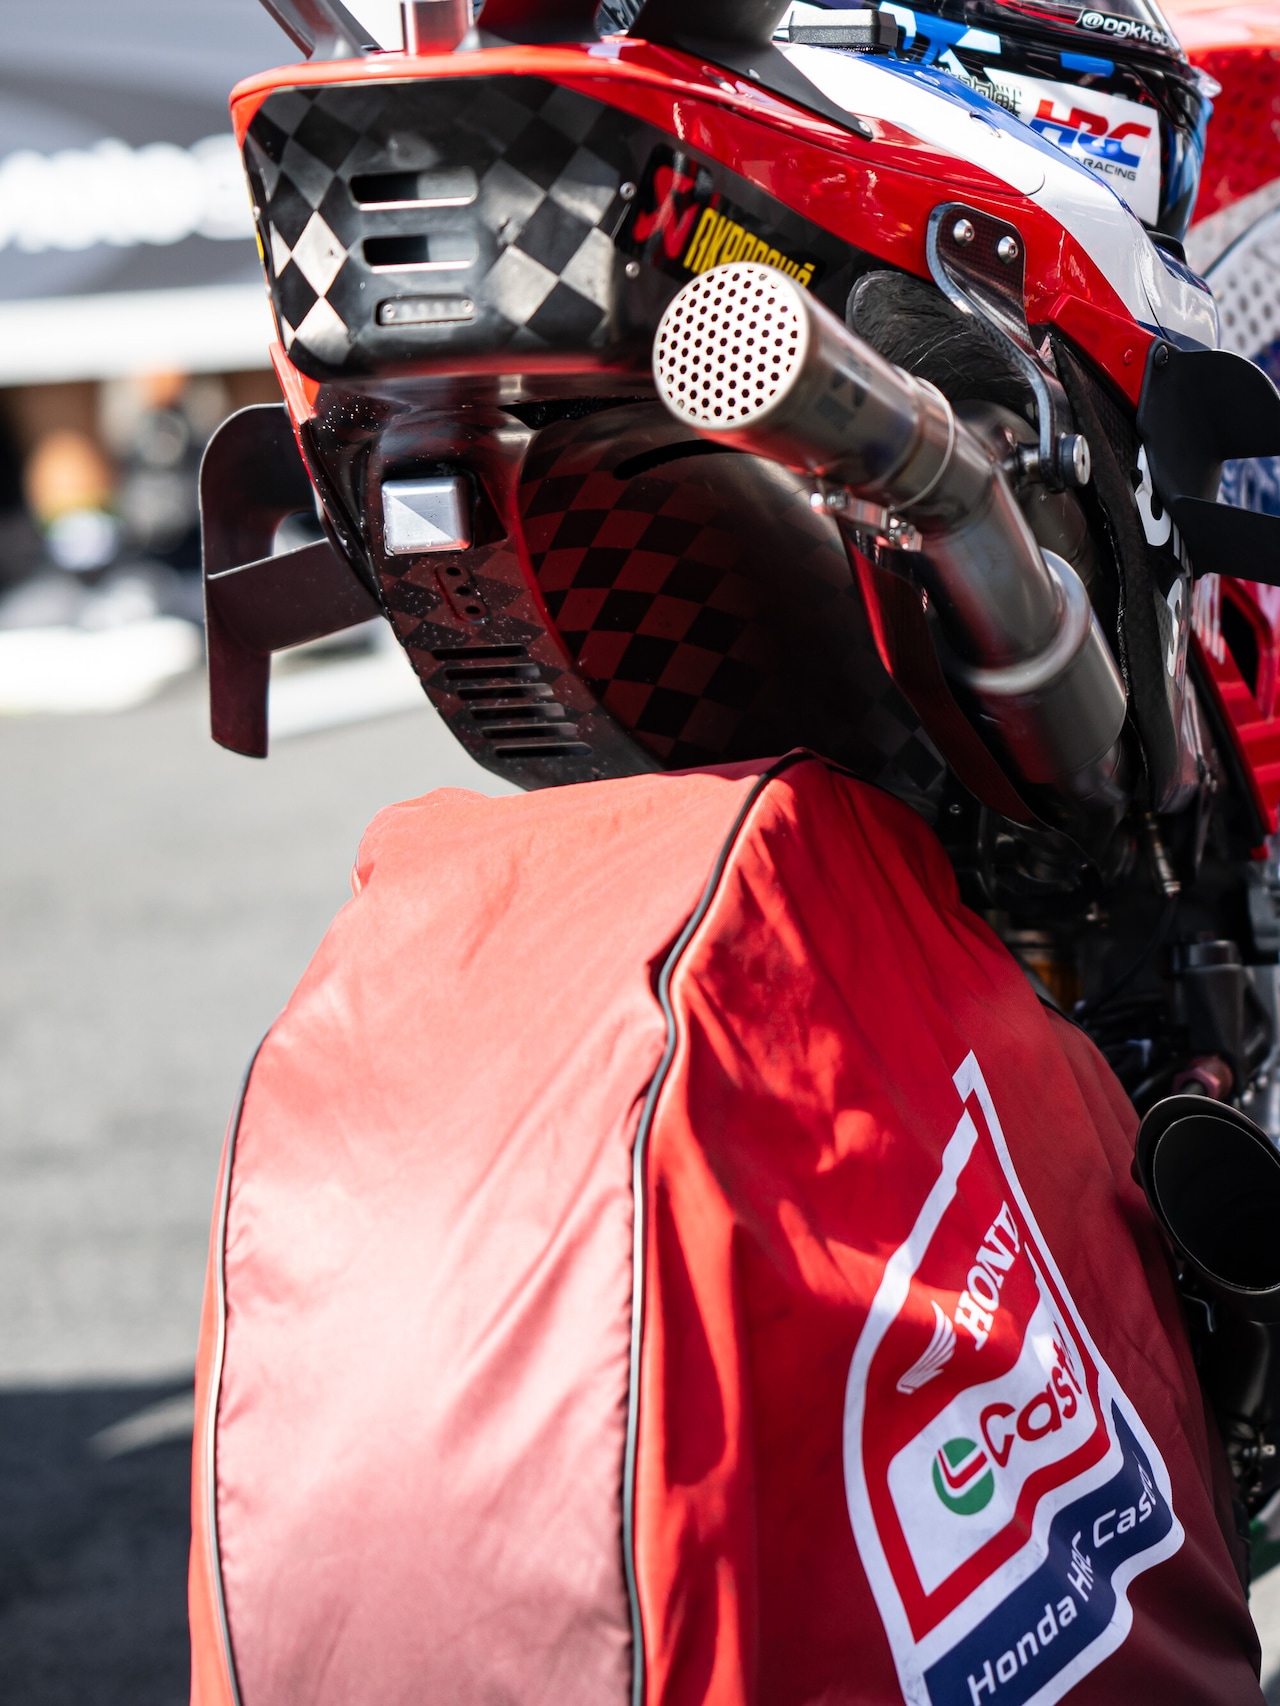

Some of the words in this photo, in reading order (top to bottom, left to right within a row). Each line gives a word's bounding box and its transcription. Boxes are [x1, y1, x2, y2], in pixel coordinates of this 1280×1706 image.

[1029, 98, 1152, 169] HRC
[1083, 158, 1137, 182] RACING
[967, 1594, 1078, 1706] Honda
